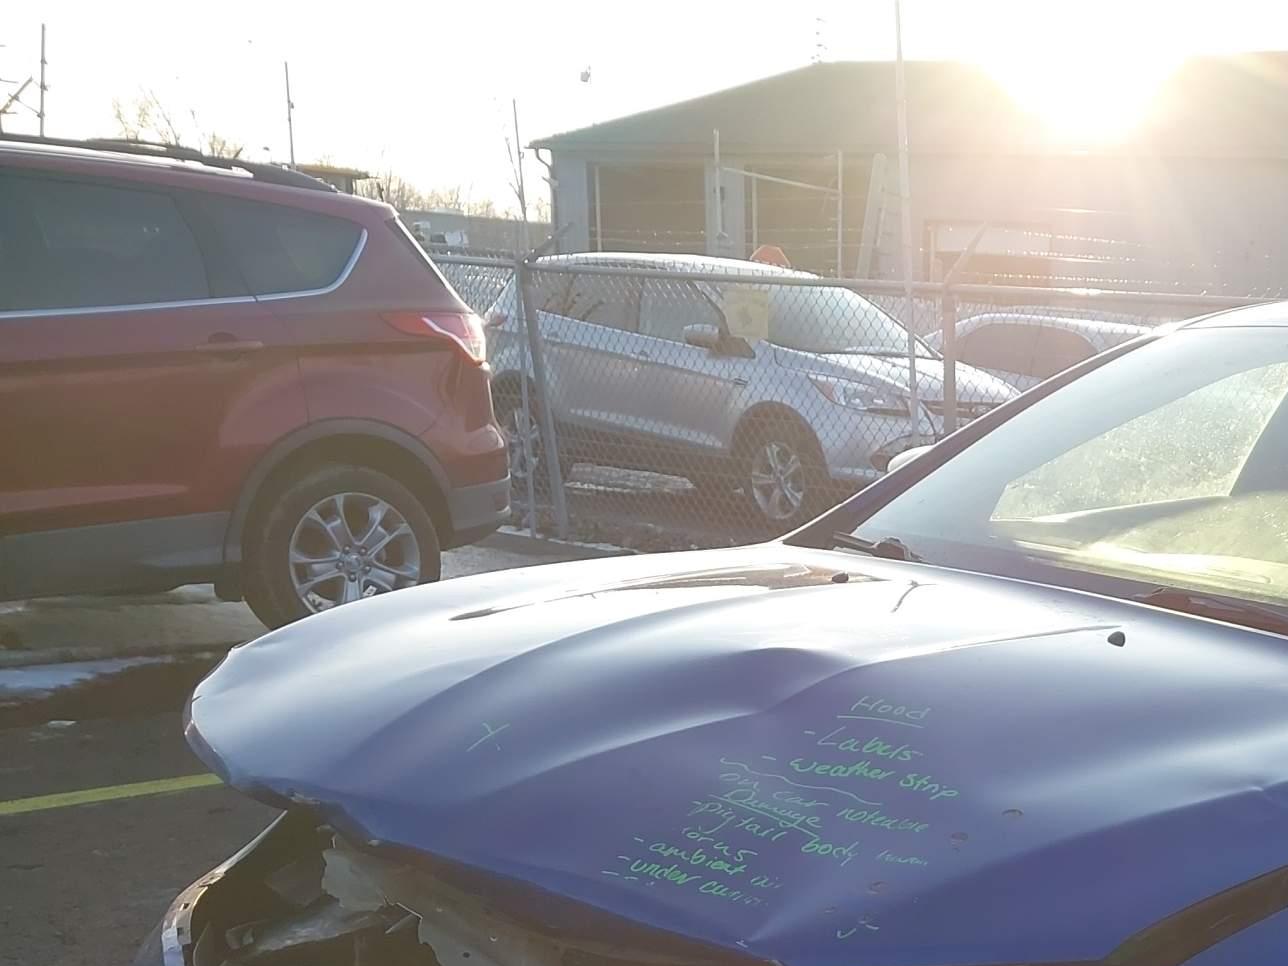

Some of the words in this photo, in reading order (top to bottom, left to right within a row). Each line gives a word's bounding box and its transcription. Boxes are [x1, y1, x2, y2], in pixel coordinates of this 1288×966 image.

[850, 695, 932, 720] Hood
[801, 834, 859, 867] body
[630, 859, 702, 885] under
